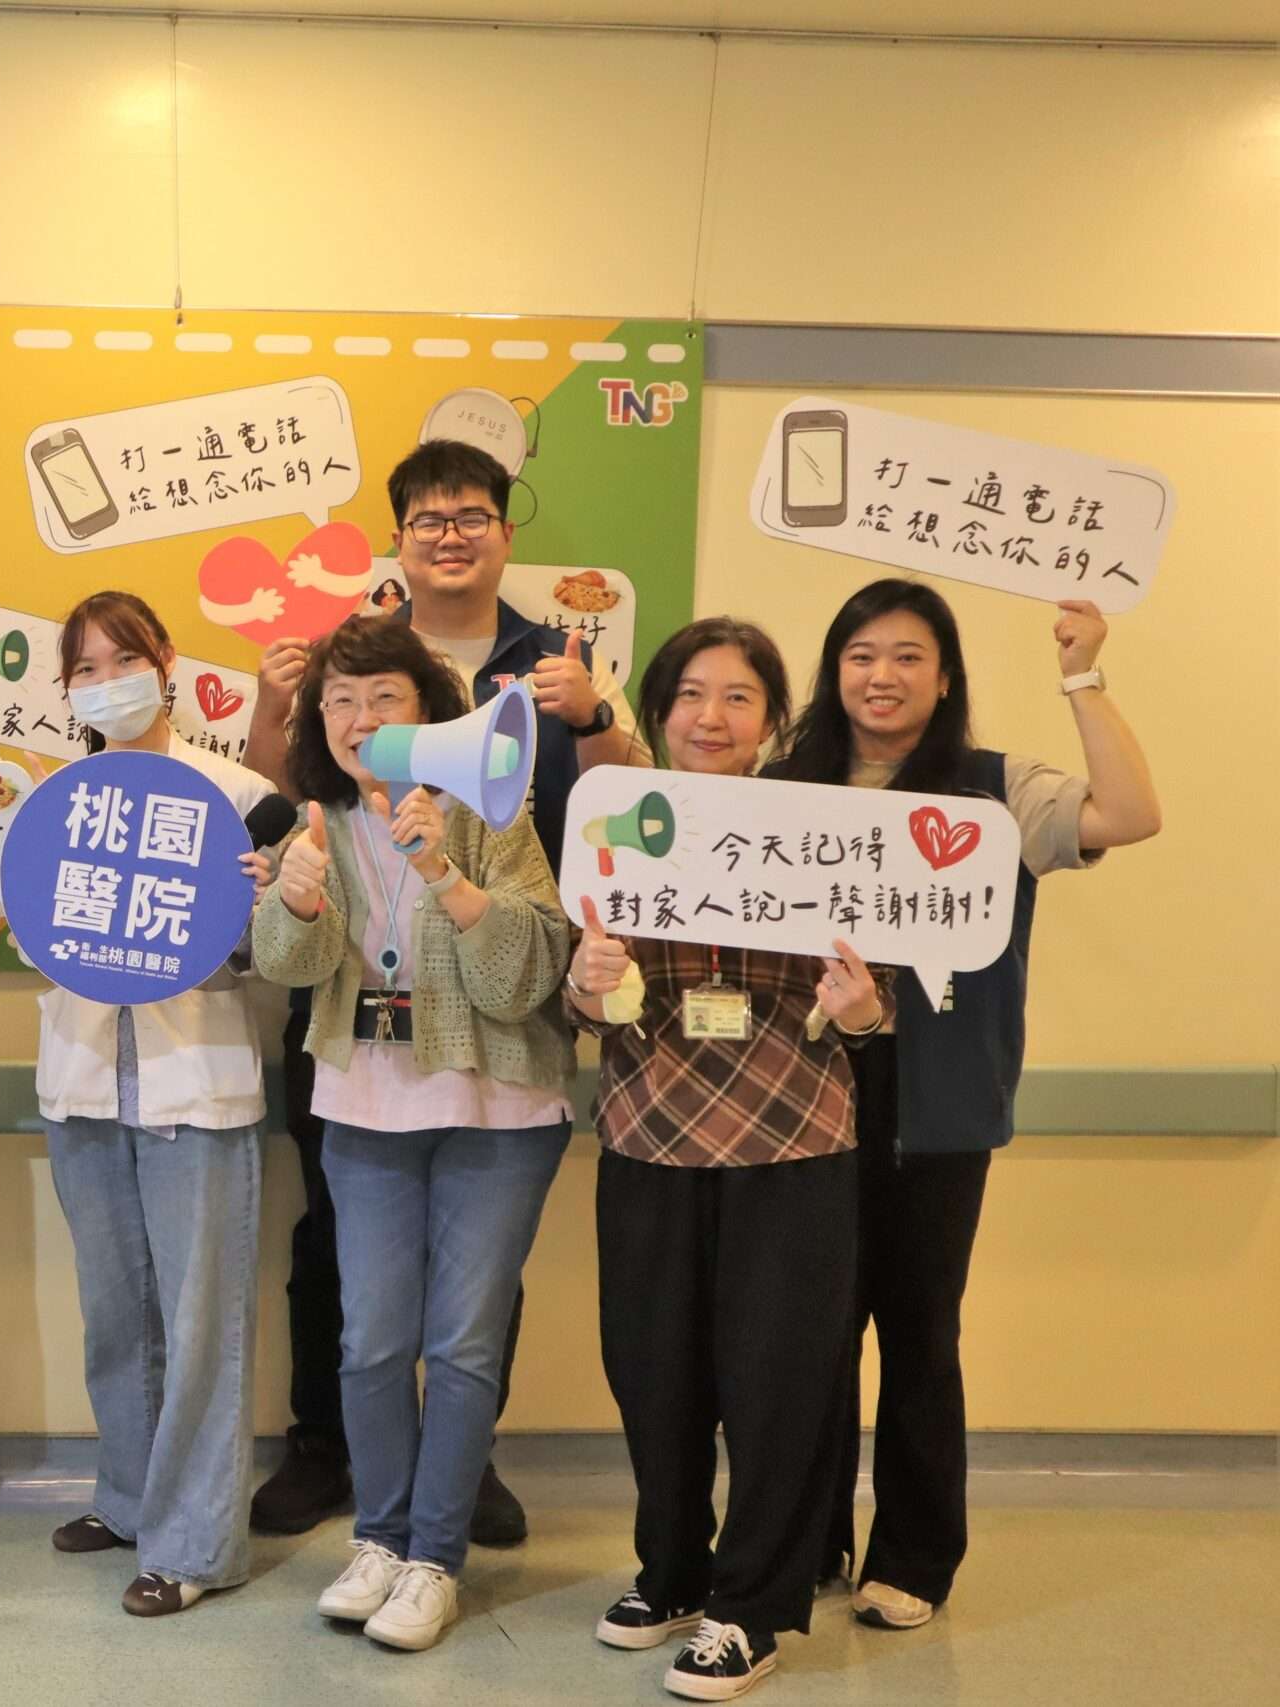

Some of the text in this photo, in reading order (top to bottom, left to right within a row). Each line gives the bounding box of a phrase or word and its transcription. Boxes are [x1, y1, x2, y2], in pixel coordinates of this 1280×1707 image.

[120, 416, 307, 473] 打一通電話
[456, 410, 508, 434] JESUS
[128, 456, 352, 515] 給想念你的人
[873, 457, 1105, 532] 打一通電話
[856, 503, 1140, 587] 給想念你的人
[65, 782, 209, 868] 桃園
[711, 826, 886, 873] 今天記得
[52, 859, 197, 946] 醫院
[605, 883, 994, 934] 對家人說一聲謝謝！
[107, 946, 181, 975] 桃園醫院
